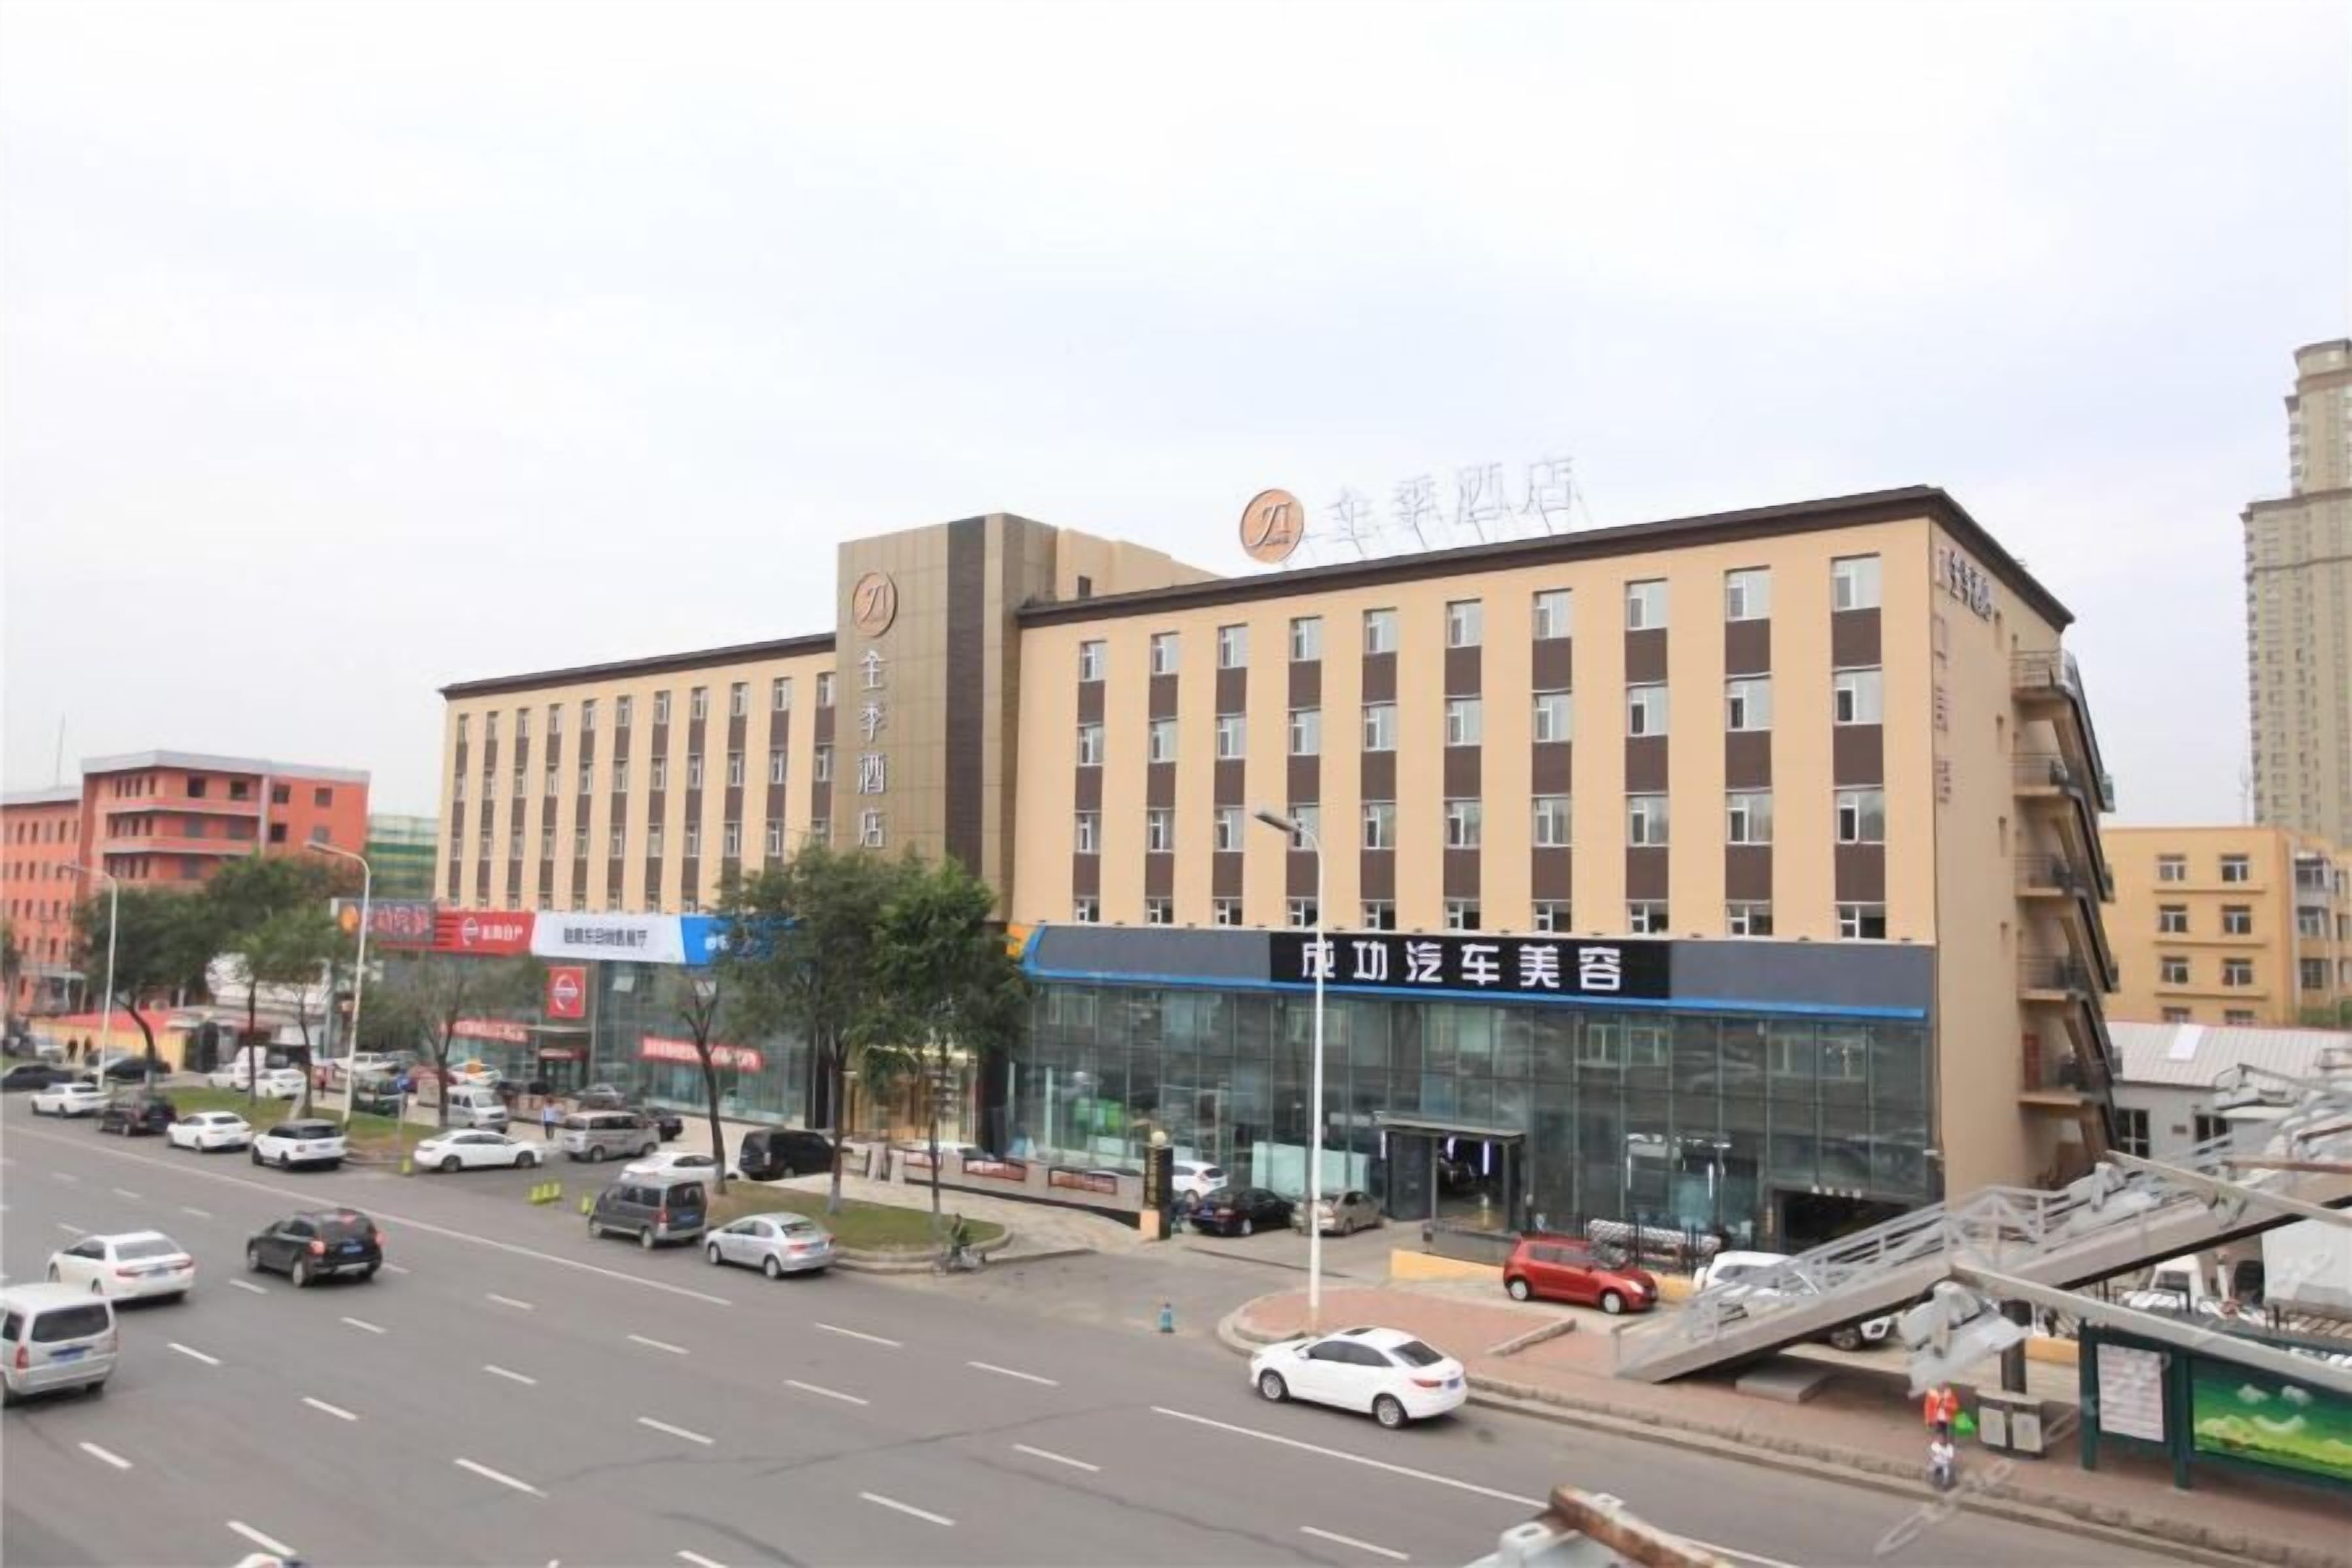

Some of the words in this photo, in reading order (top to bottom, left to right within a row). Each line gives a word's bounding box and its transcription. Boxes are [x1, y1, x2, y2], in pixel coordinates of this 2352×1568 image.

[858, 650, 887, 848] 全季酒店
[1301, 940, 1621, 990] 成功汽车美容
